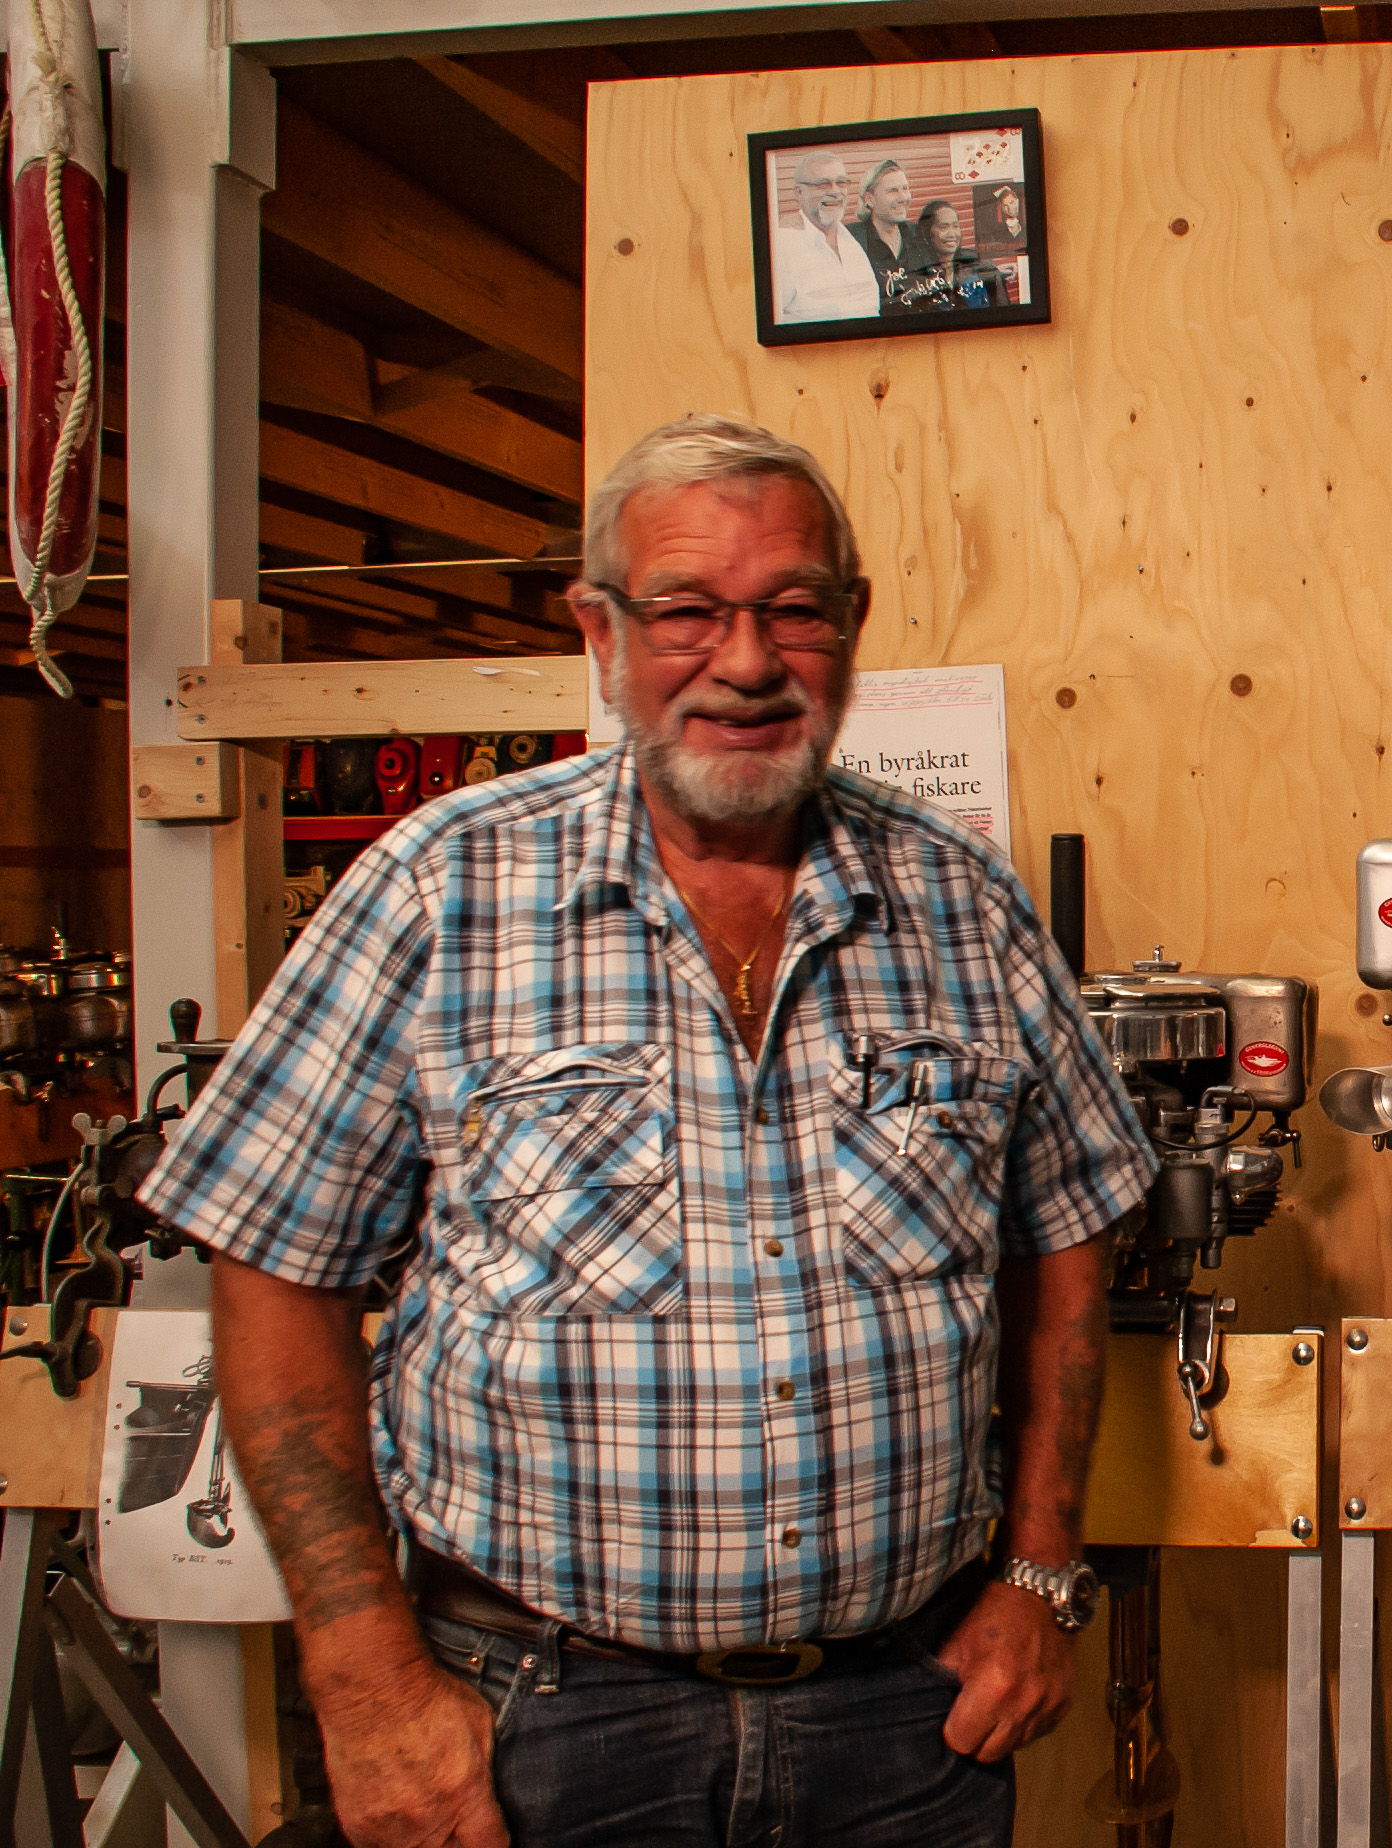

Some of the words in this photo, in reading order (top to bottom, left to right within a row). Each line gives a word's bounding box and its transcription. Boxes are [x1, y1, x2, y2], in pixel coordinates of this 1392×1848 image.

[841, 754, 871, 774] En
[879, 750, 970, 778] byråkrat
[913, 776, 982, 798] fiskare
